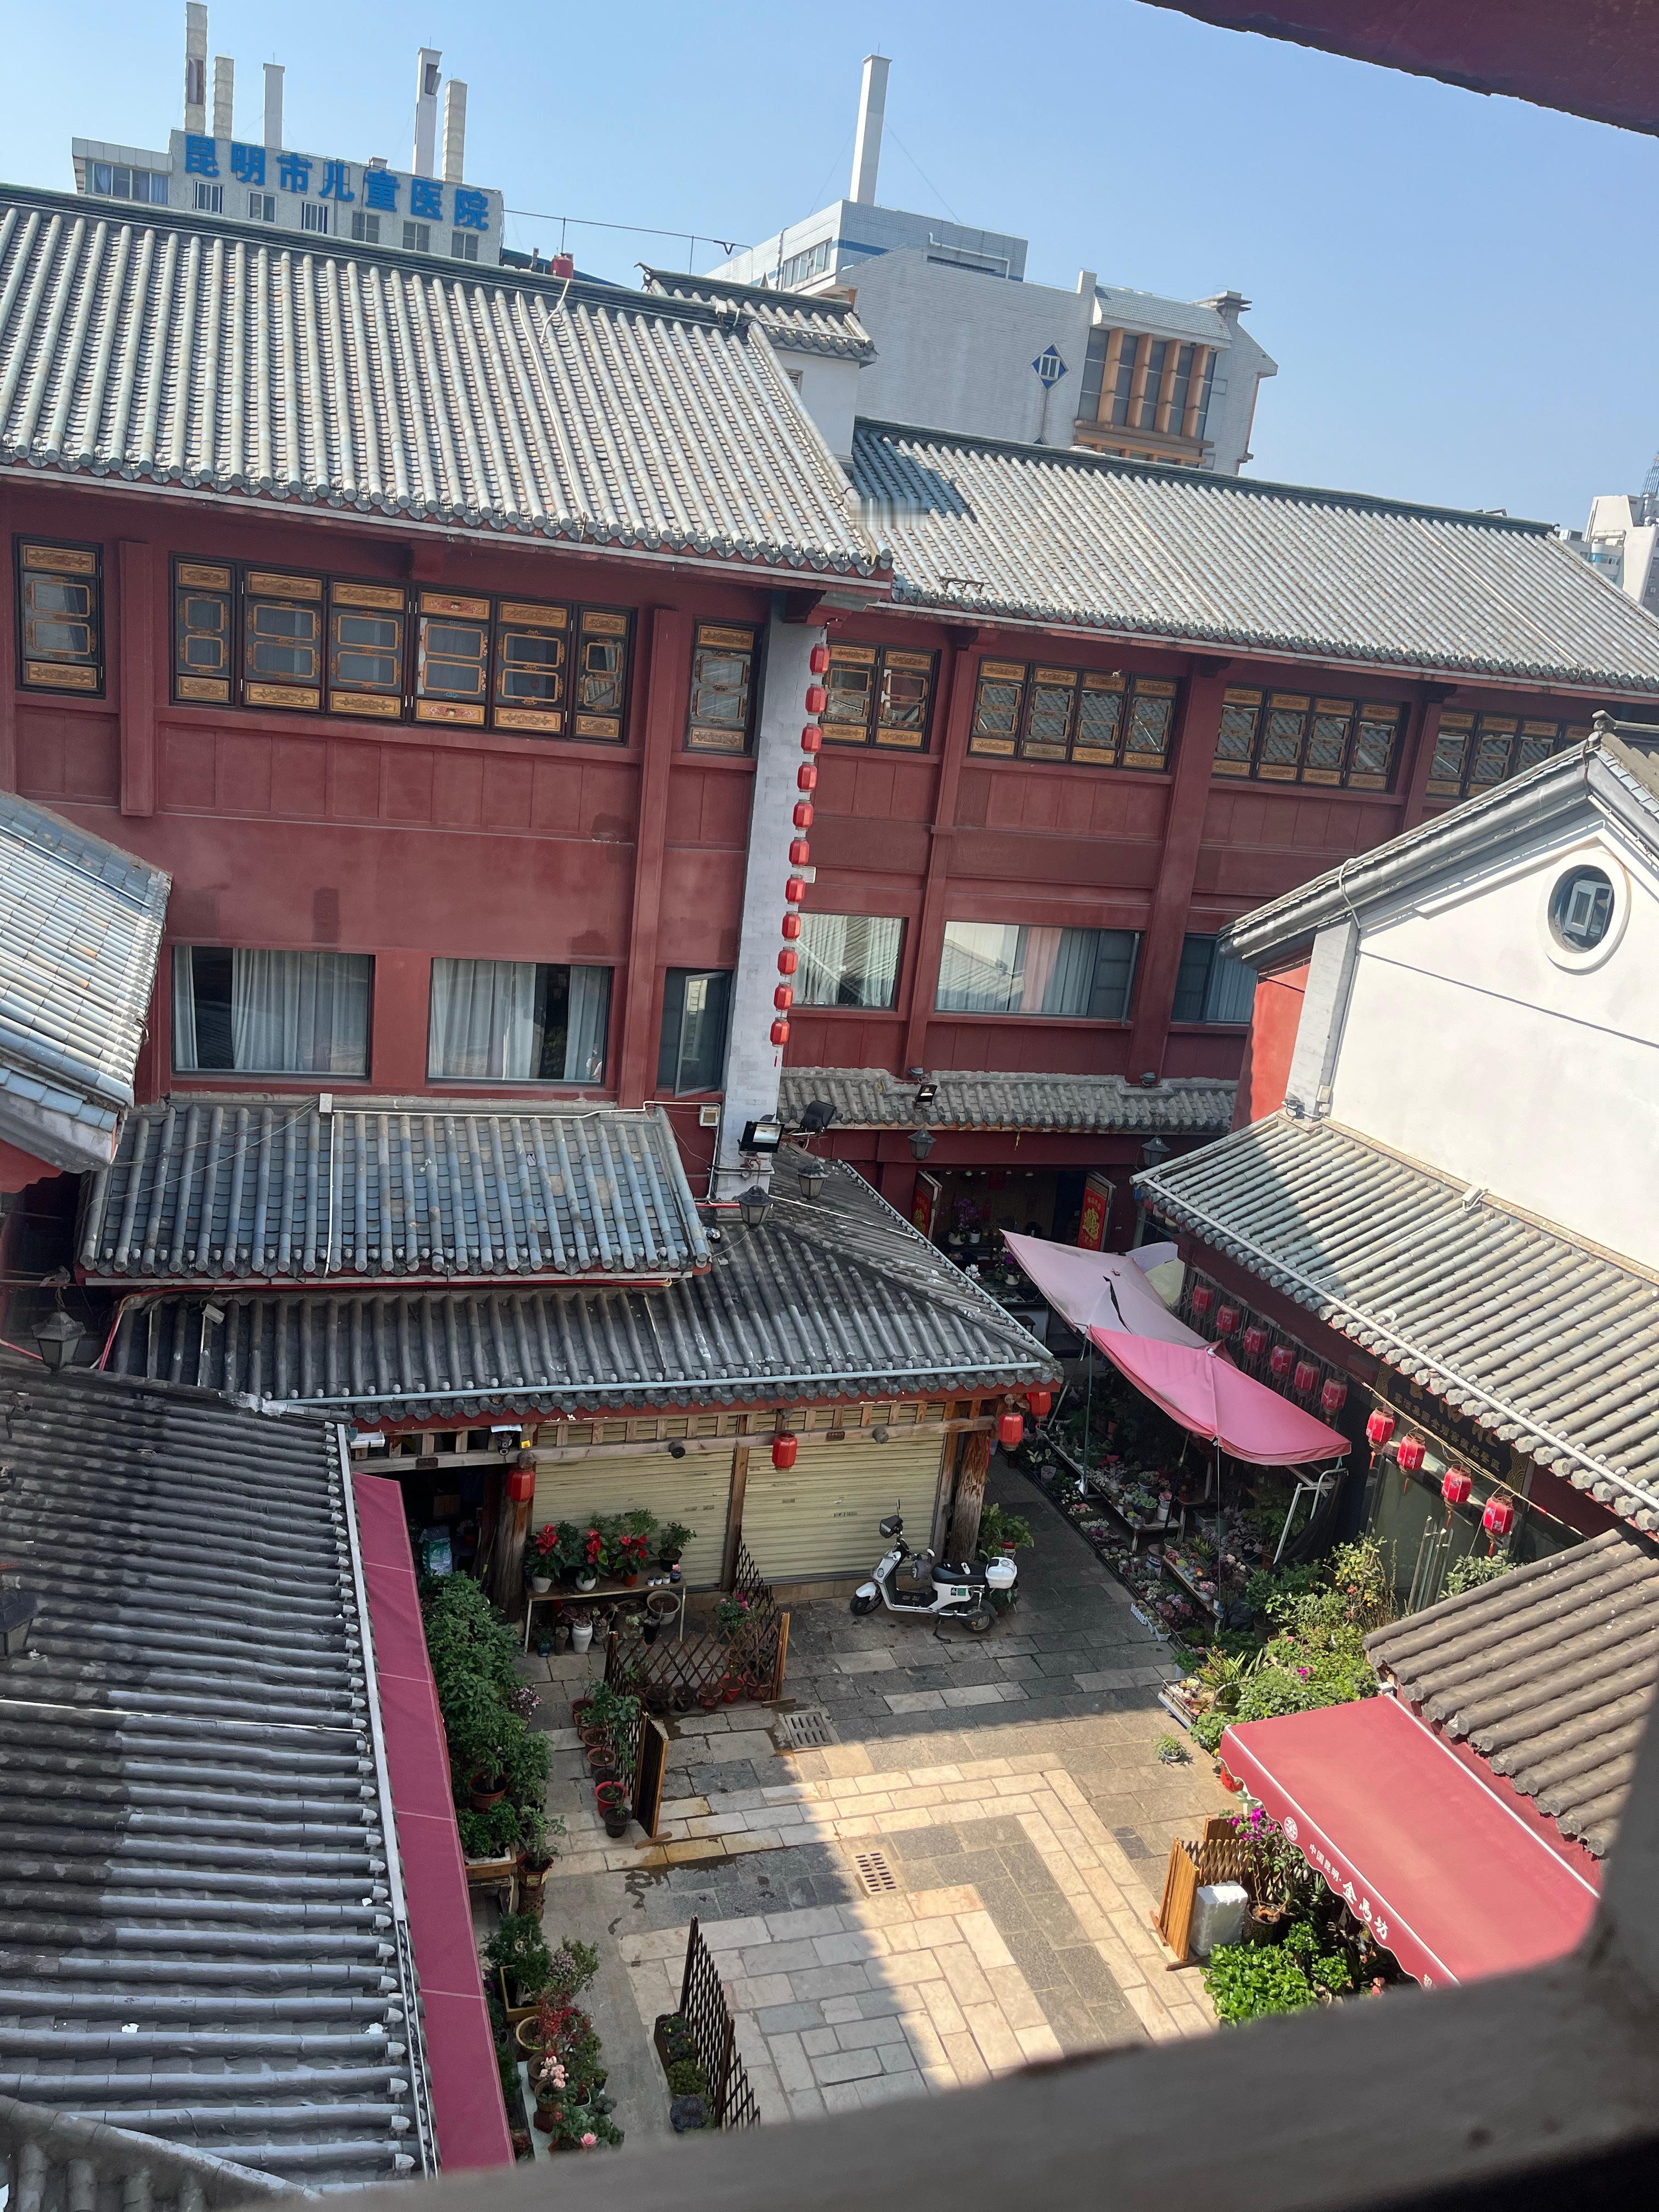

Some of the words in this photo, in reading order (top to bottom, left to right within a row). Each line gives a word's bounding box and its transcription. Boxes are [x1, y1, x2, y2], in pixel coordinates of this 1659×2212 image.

[185, 134, 489, 230] 昆明市儿童医院
